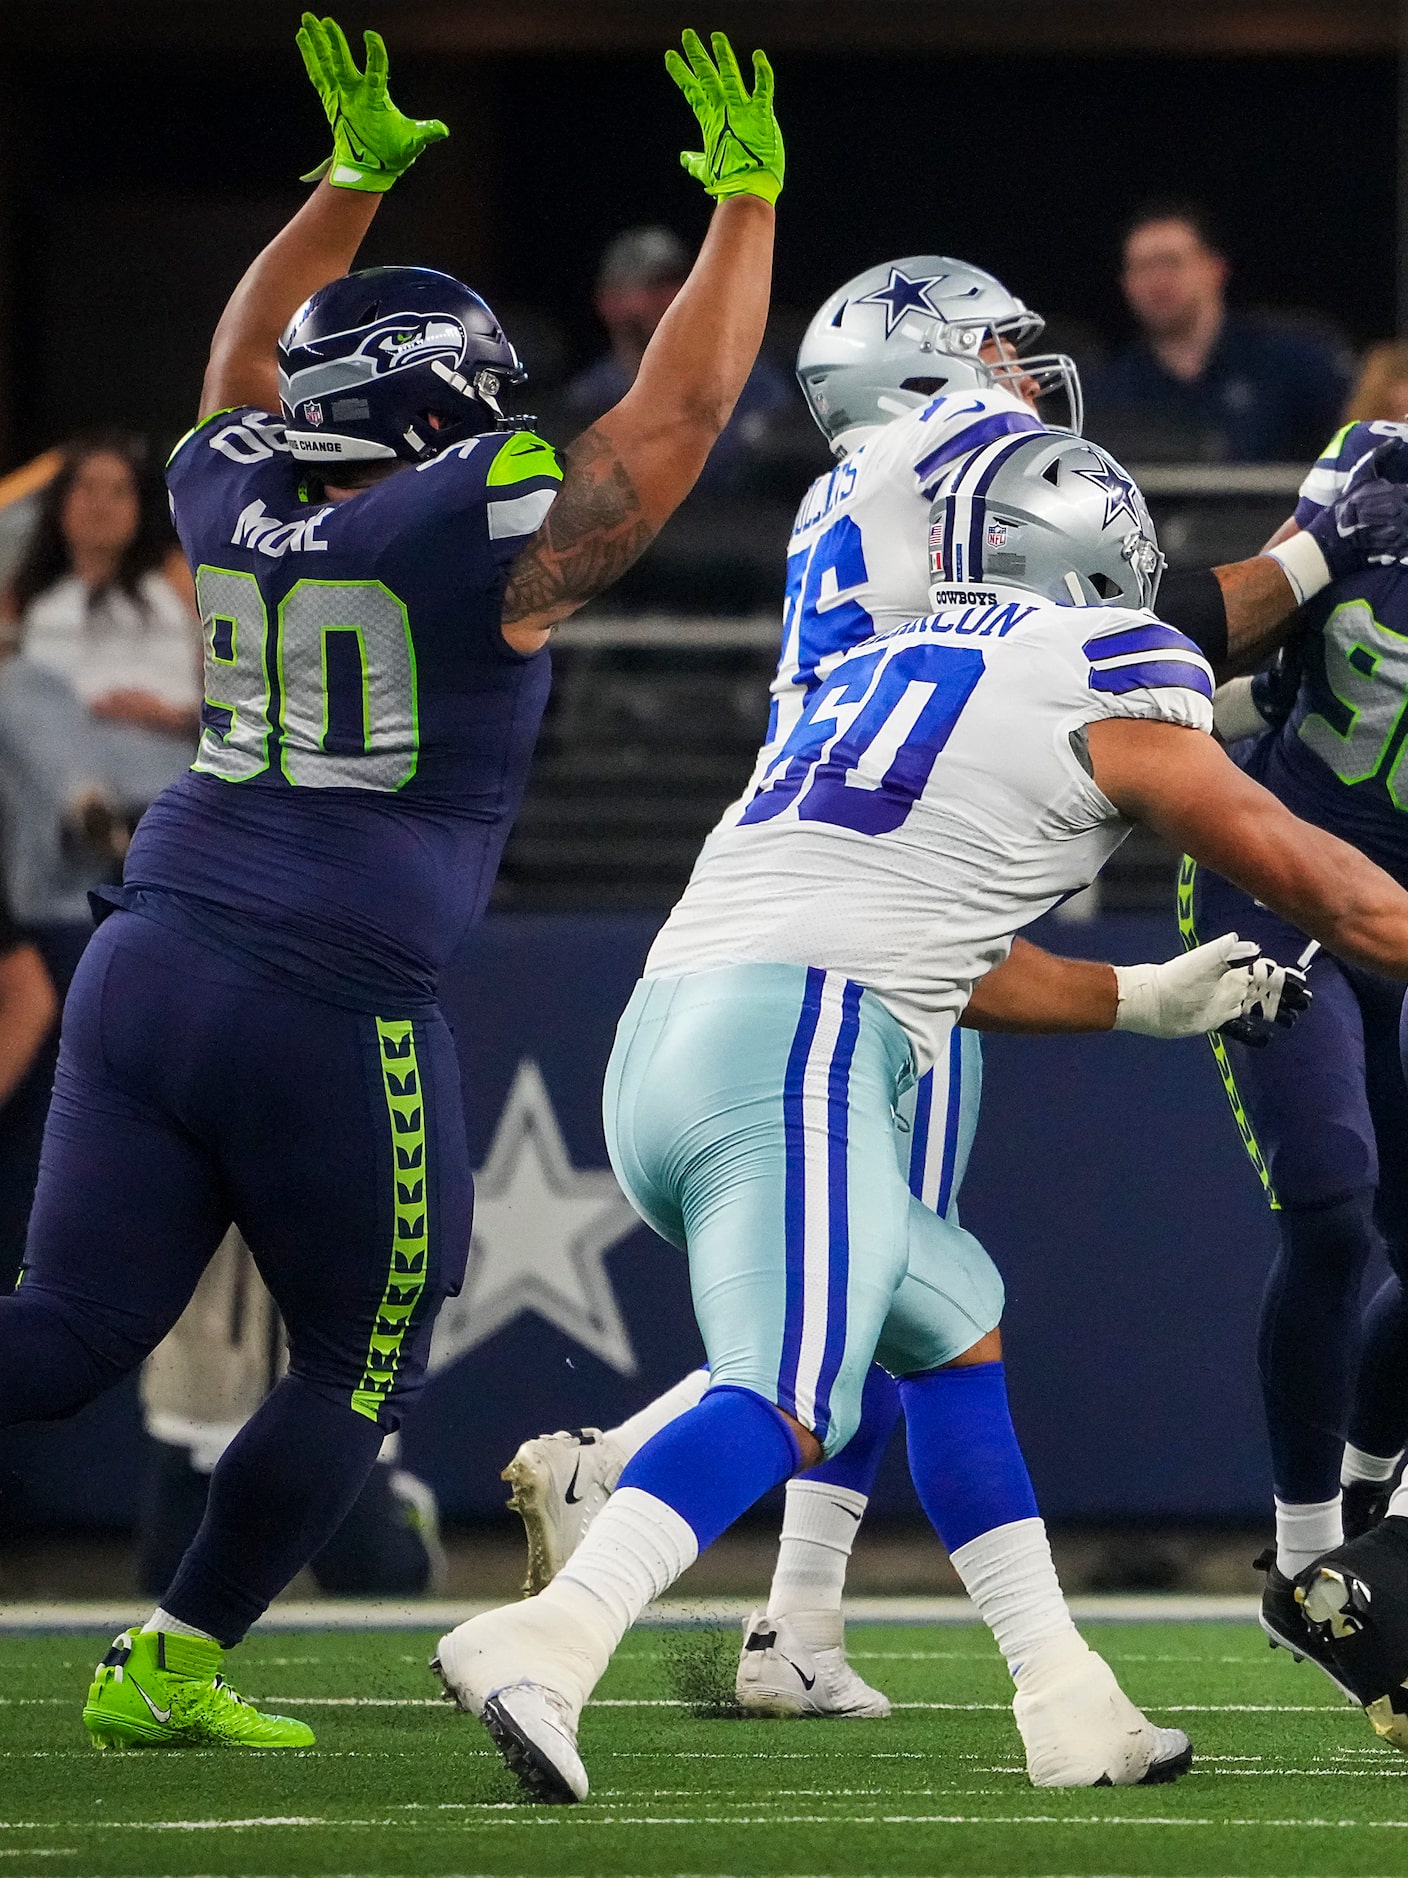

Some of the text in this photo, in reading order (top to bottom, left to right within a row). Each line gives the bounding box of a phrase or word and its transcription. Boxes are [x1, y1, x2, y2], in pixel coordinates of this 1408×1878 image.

[299, 440, 342, 452] CHANGE
[936, 590, 998, 605] COWBOYS
[190, 564, 420, 793] 90
[735, 644, 986, 836] 60
